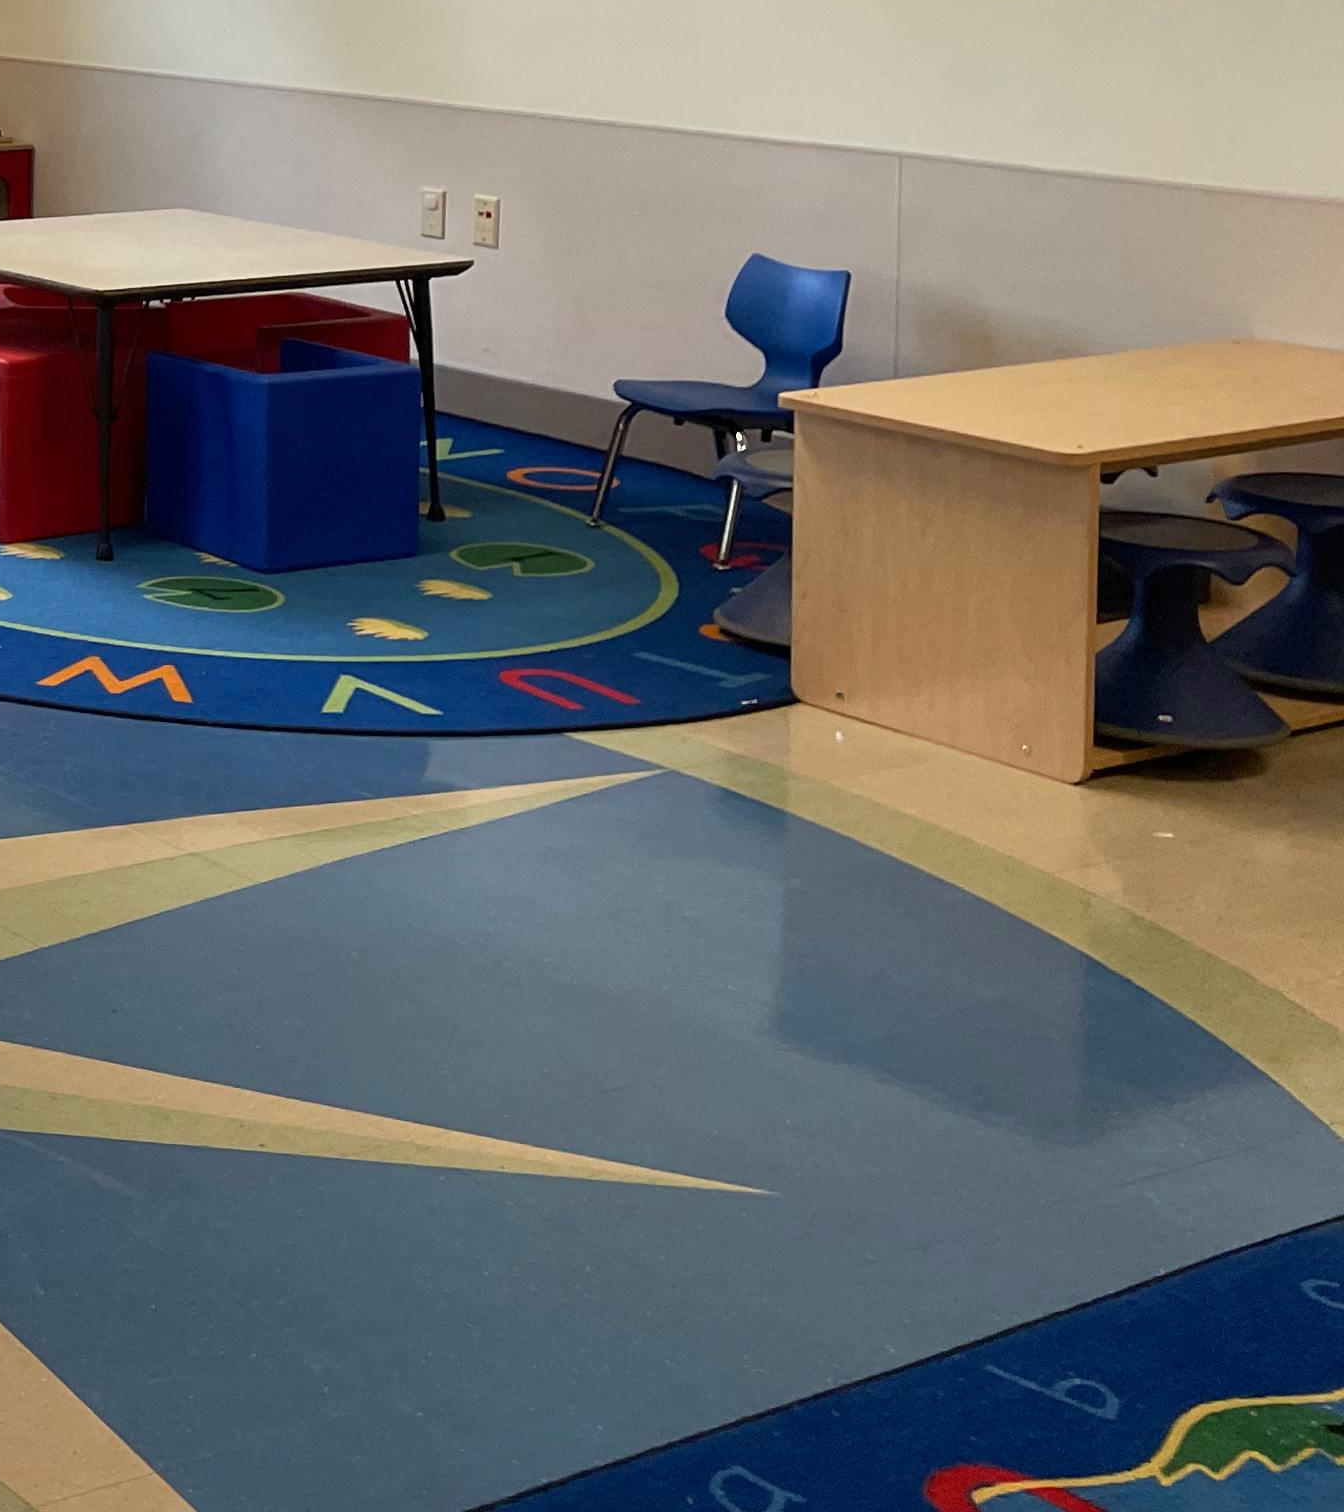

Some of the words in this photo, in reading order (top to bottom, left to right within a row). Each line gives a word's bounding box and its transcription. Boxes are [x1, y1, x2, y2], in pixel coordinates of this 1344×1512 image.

[35, 654, 193, 704] W
[320, 674, 444, 715] V
[499, 668, 642, 710] U
